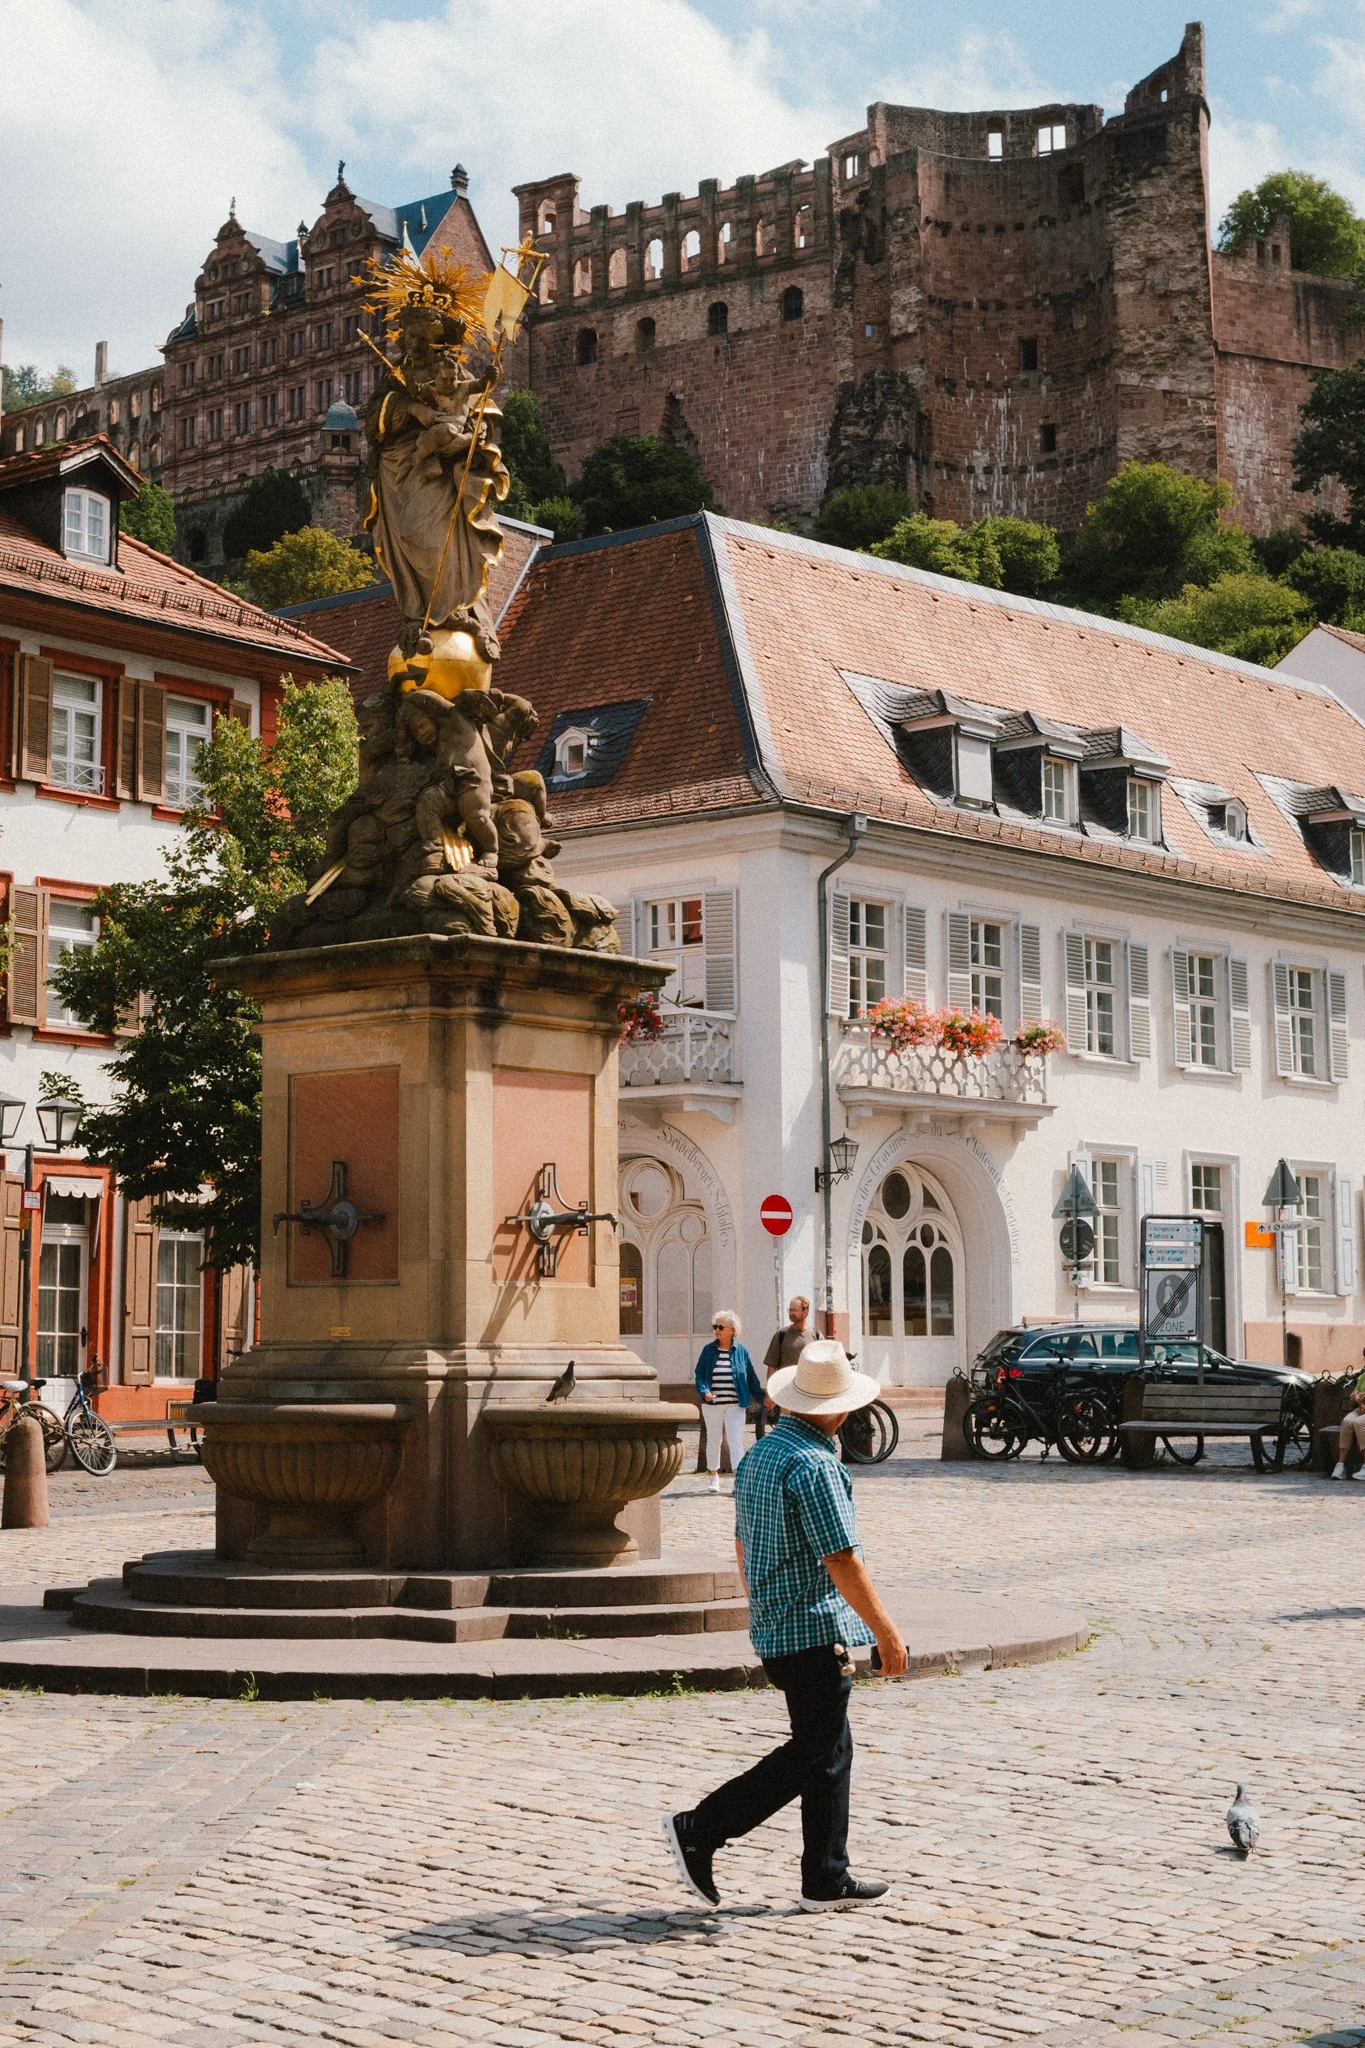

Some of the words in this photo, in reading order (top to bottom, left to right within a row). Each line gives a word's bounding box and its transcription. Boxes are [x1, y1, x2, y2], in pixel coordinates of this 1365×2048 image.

[849, 1204, 864, 1257] Galerie
[858, 1179, 873, 1202] des
[1159, 1321, 1185, 1333] ZONE
